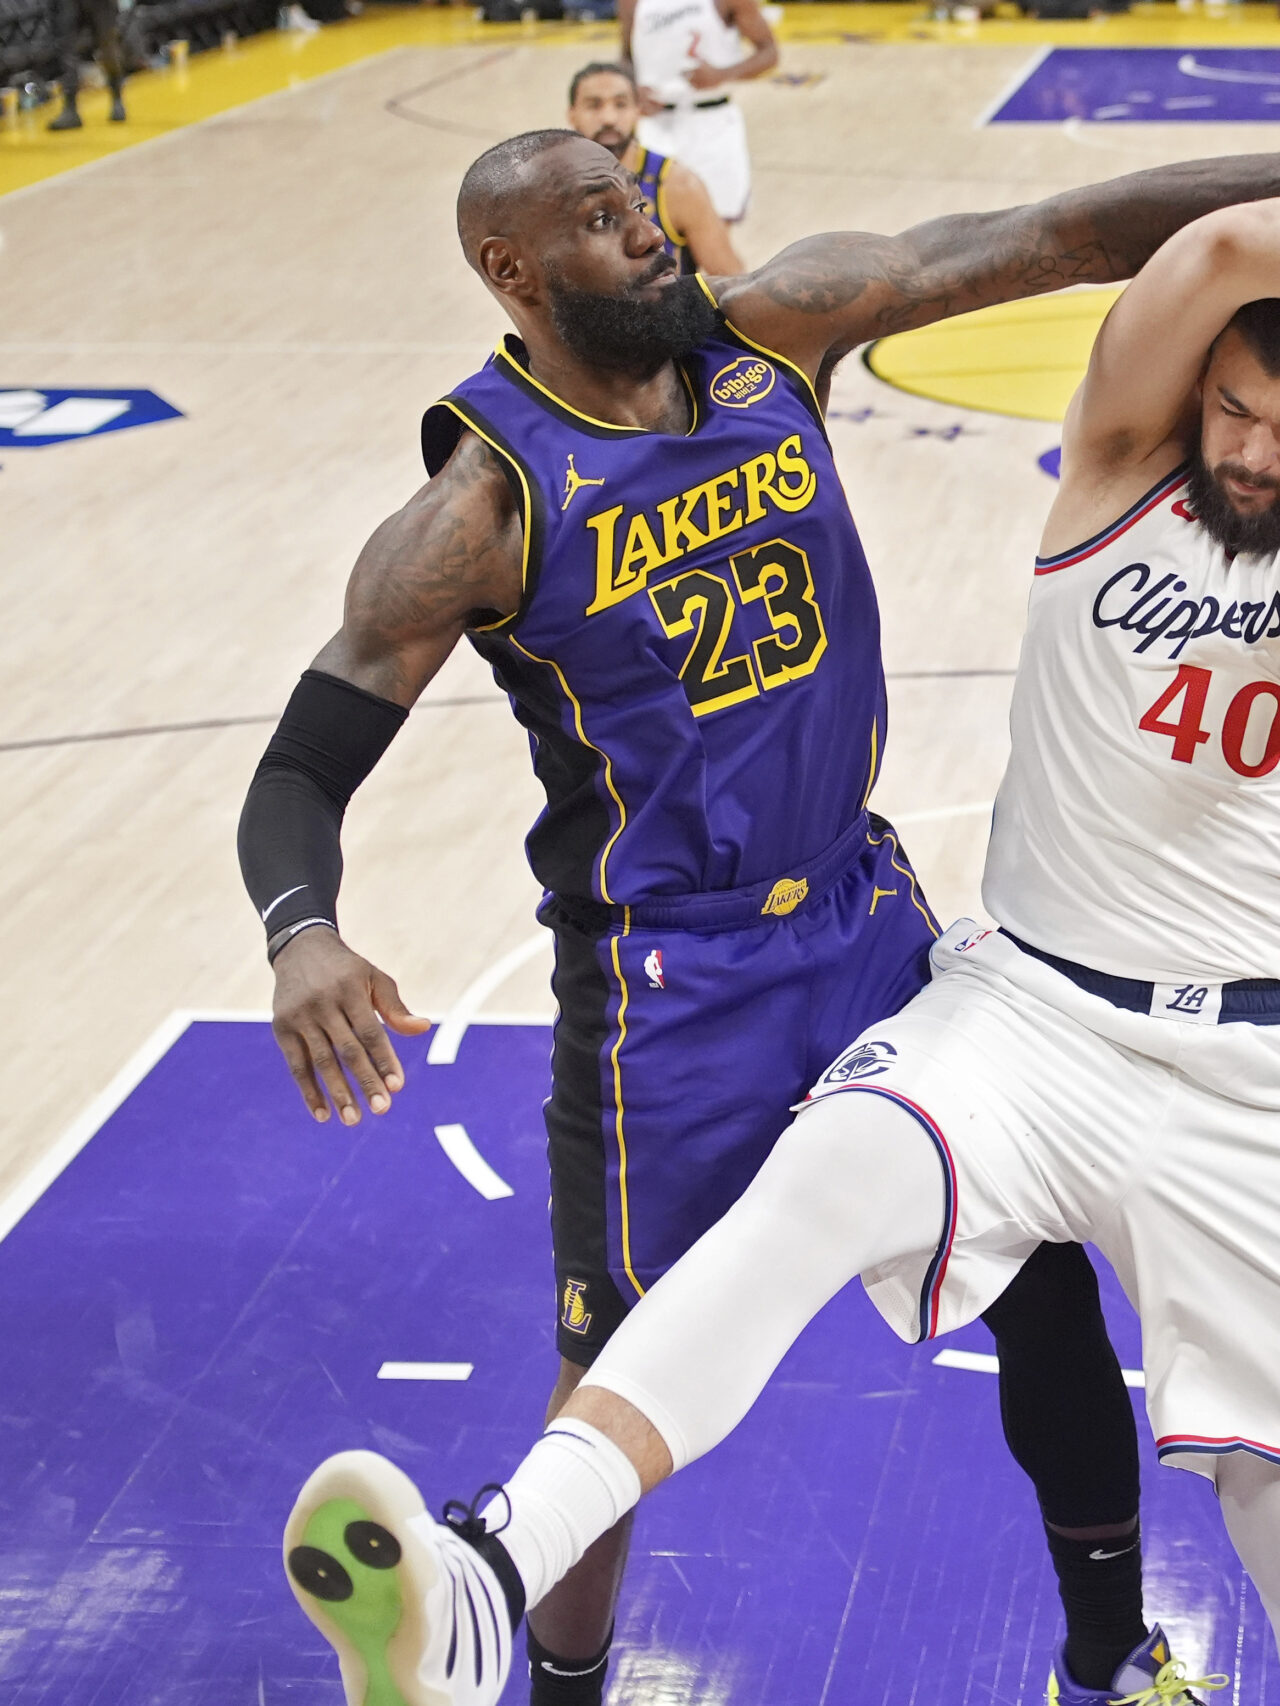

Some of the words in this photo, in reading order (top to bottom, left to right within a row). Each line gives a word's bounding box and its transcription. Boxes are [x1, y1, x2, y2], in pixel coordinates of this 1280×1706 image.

[714, 363, 767, 400] bibigo
[585, 434, 817, 617] LAKERS
[648, 538, 829, 718] 23
[1165, 984, 1209, 1015] LA
